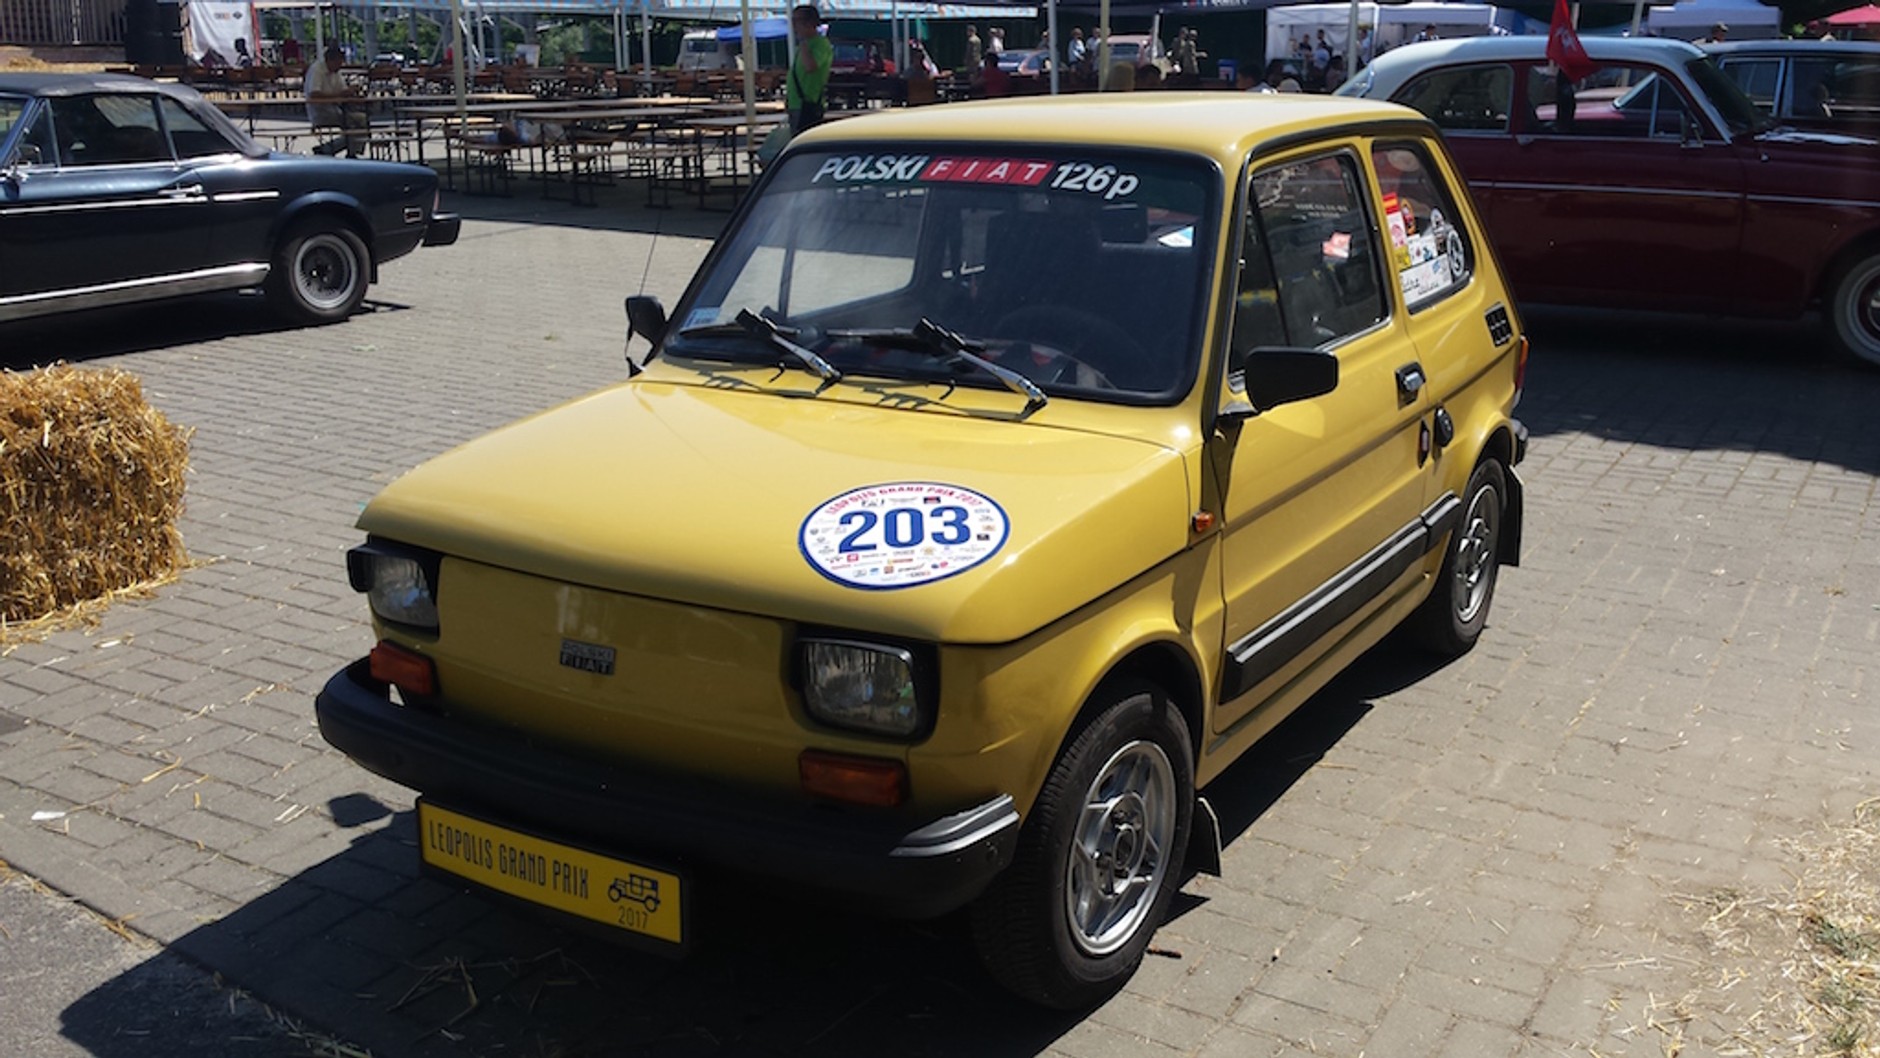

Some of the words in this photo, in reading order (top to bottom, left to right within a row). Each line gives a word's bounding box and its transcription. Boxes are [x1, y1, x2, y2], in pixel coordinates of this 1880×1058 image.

[812, 156, 929, 183] POLSKI
[930, 161, 1047, 182] FIAT
[1051, 162, 1139, 199] 126p
[879, 486, 924, 495] GRAND
[927, 487, 955, 497] PRIX
[838, 506, 971, 554] 203
[562, 653, 612, 674] FIAT
[429, 820, 492, 869] LEOPOLIS
[499, 843, 546, 886] GRAND
[553, 860, 588, 899] PRIX
[618, 906, 648, 929] 2017
